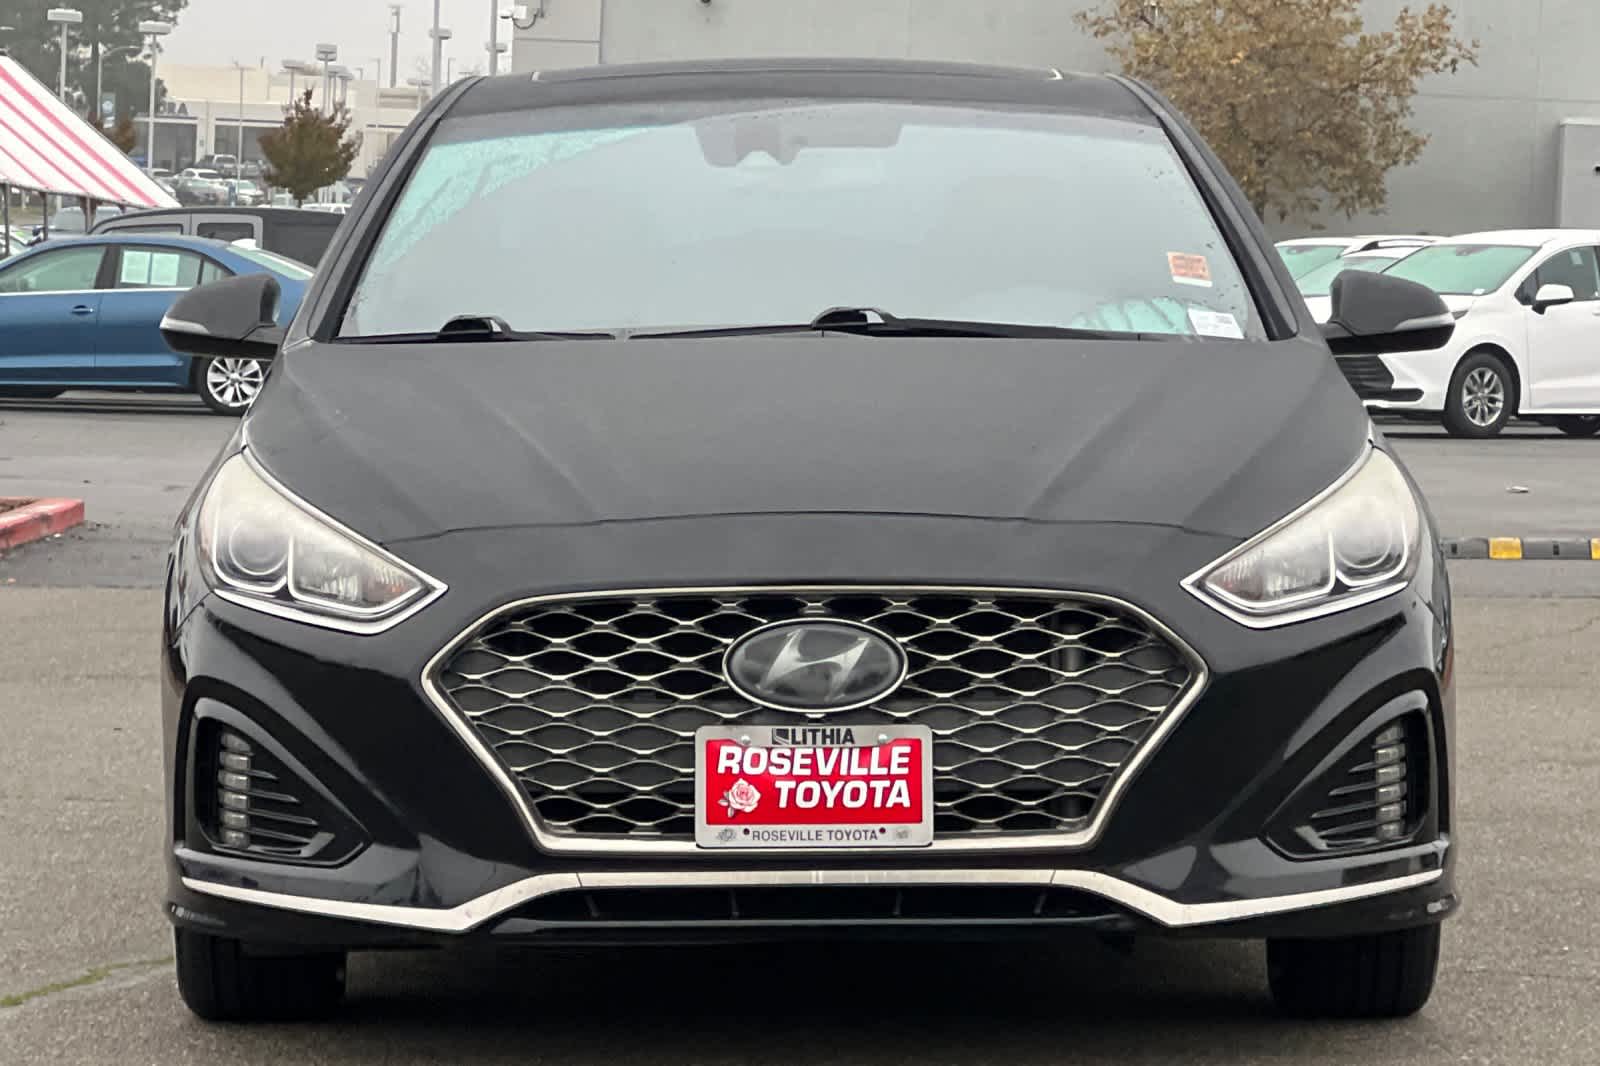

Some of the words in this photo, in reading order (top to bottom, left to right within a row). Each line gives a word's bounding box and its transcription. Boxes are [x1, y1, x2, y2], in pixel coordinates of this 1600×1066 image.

[791, 728, 855, 745] LITHIA
[717, 745, 911, 776] ROSEVILLE
[775, 779, 911, 808] TOYOTA
[752, 830, 823, 841] ROSEVILLE
[828, 829, 878, 841] TOYOTA
